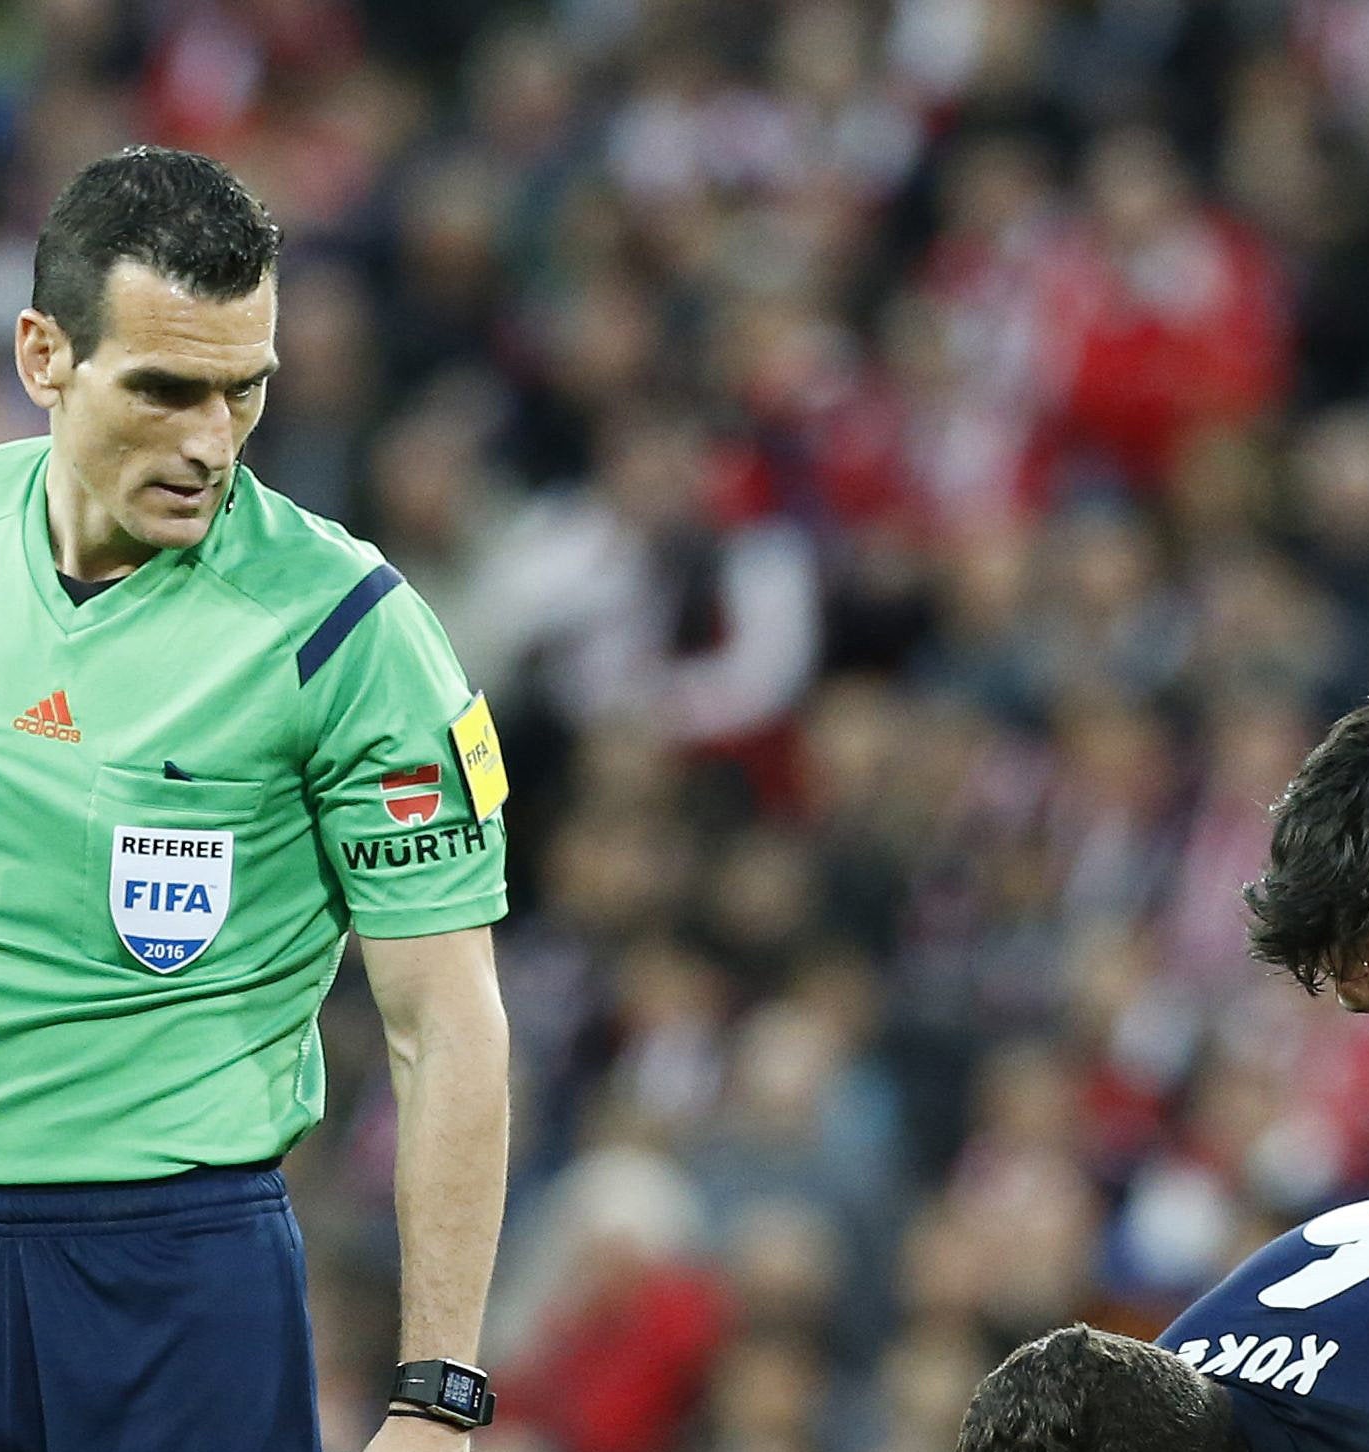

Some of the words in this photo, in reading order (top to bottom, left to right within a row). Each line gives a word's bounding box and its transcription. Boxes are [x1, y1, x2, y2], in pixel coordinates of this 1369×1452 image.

[12, 715, 81, 743] adidas
[121, 836, 224, 859] REFEREE
[341, 822, 486, 870] WÜRTH
[124, 879, 213, 914] FIFA
[143, 943, 185, 959] 2016
